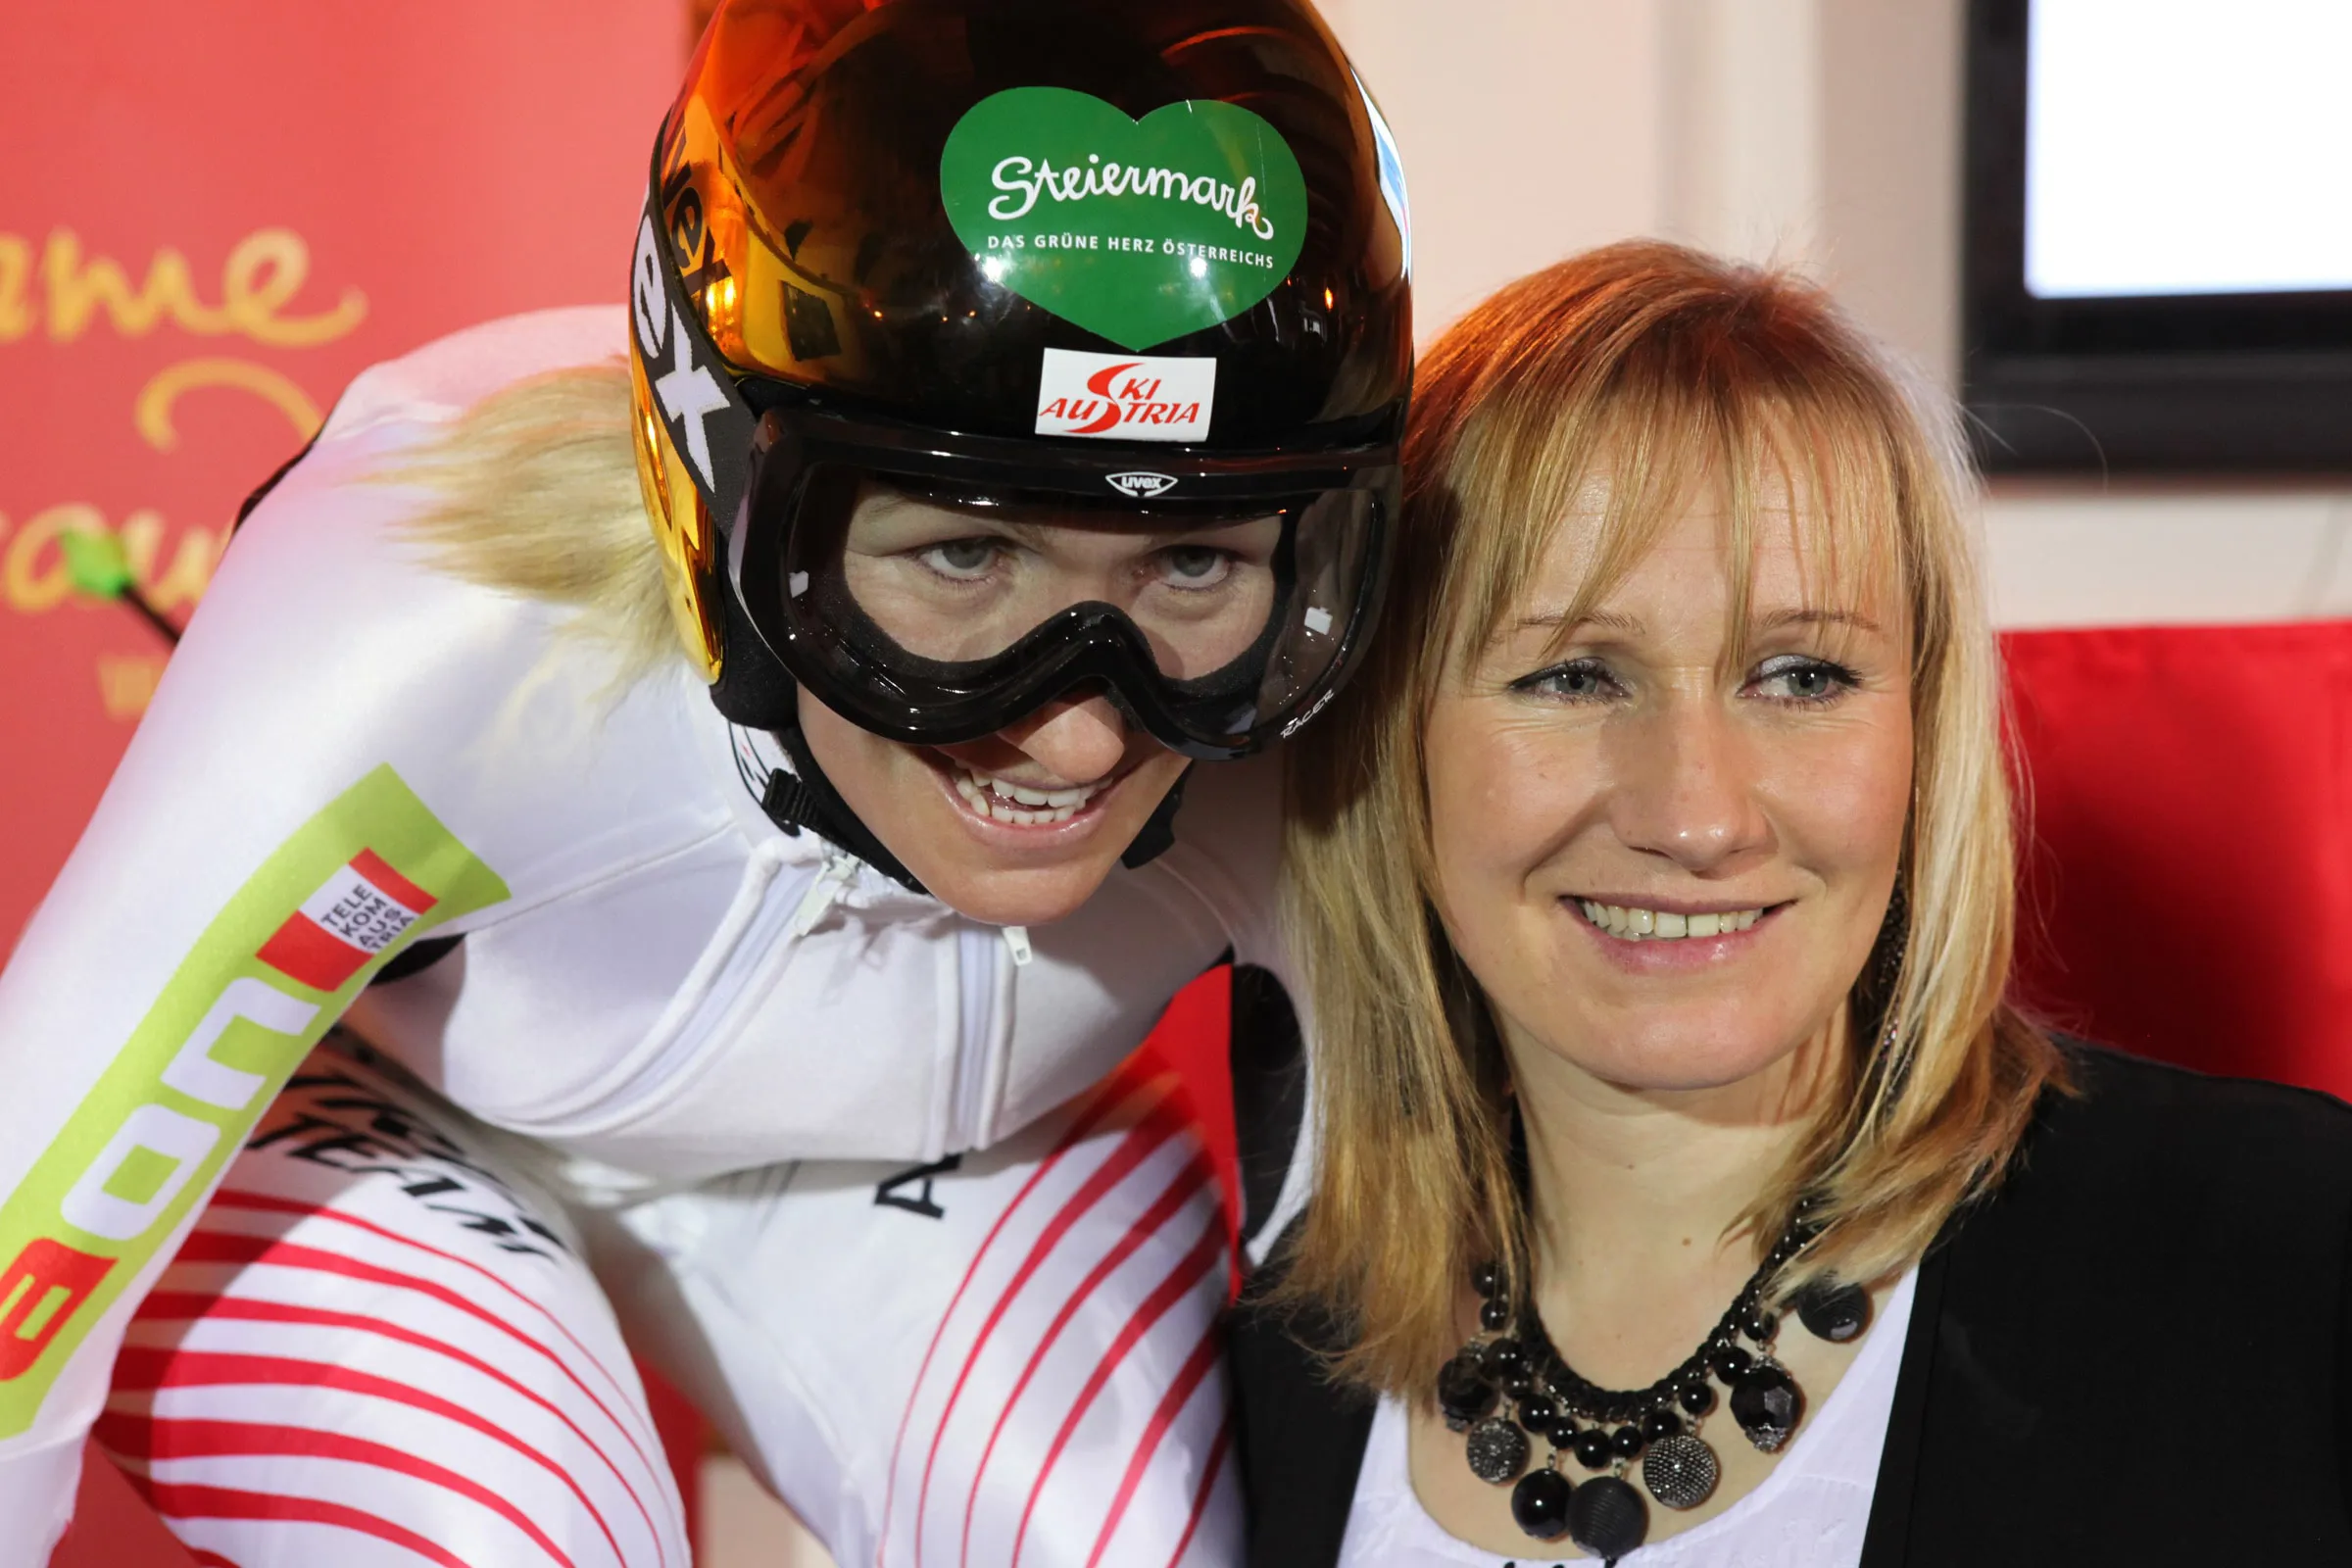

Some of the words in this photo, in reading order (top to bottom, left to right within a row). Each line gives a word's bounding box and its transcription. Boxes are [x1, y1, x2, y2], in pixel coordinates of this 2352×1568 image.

[988, 154, 1274, 240] Steiermark
[987, 234, 1025, 250] DAS
[1034, 231, 1099, 250] GRÜNE
[1107, 236, 1154, 253] HERZ
[1162, 238, 1274, 270] ÖSTERREICHS
[1080, 363, 1162, 407] SKI
[1039, 397, 1200, 434] AUSTRIA
[1121, 476, 1162, 489] uvex
[1280, 689, 1335, 739] RACER
[319, 883, 372, 927] TELE
[339, 897, 388, 938] KOM
[359, 907, 402, 947] AUS
[0, 975, 322, 1384] aon
